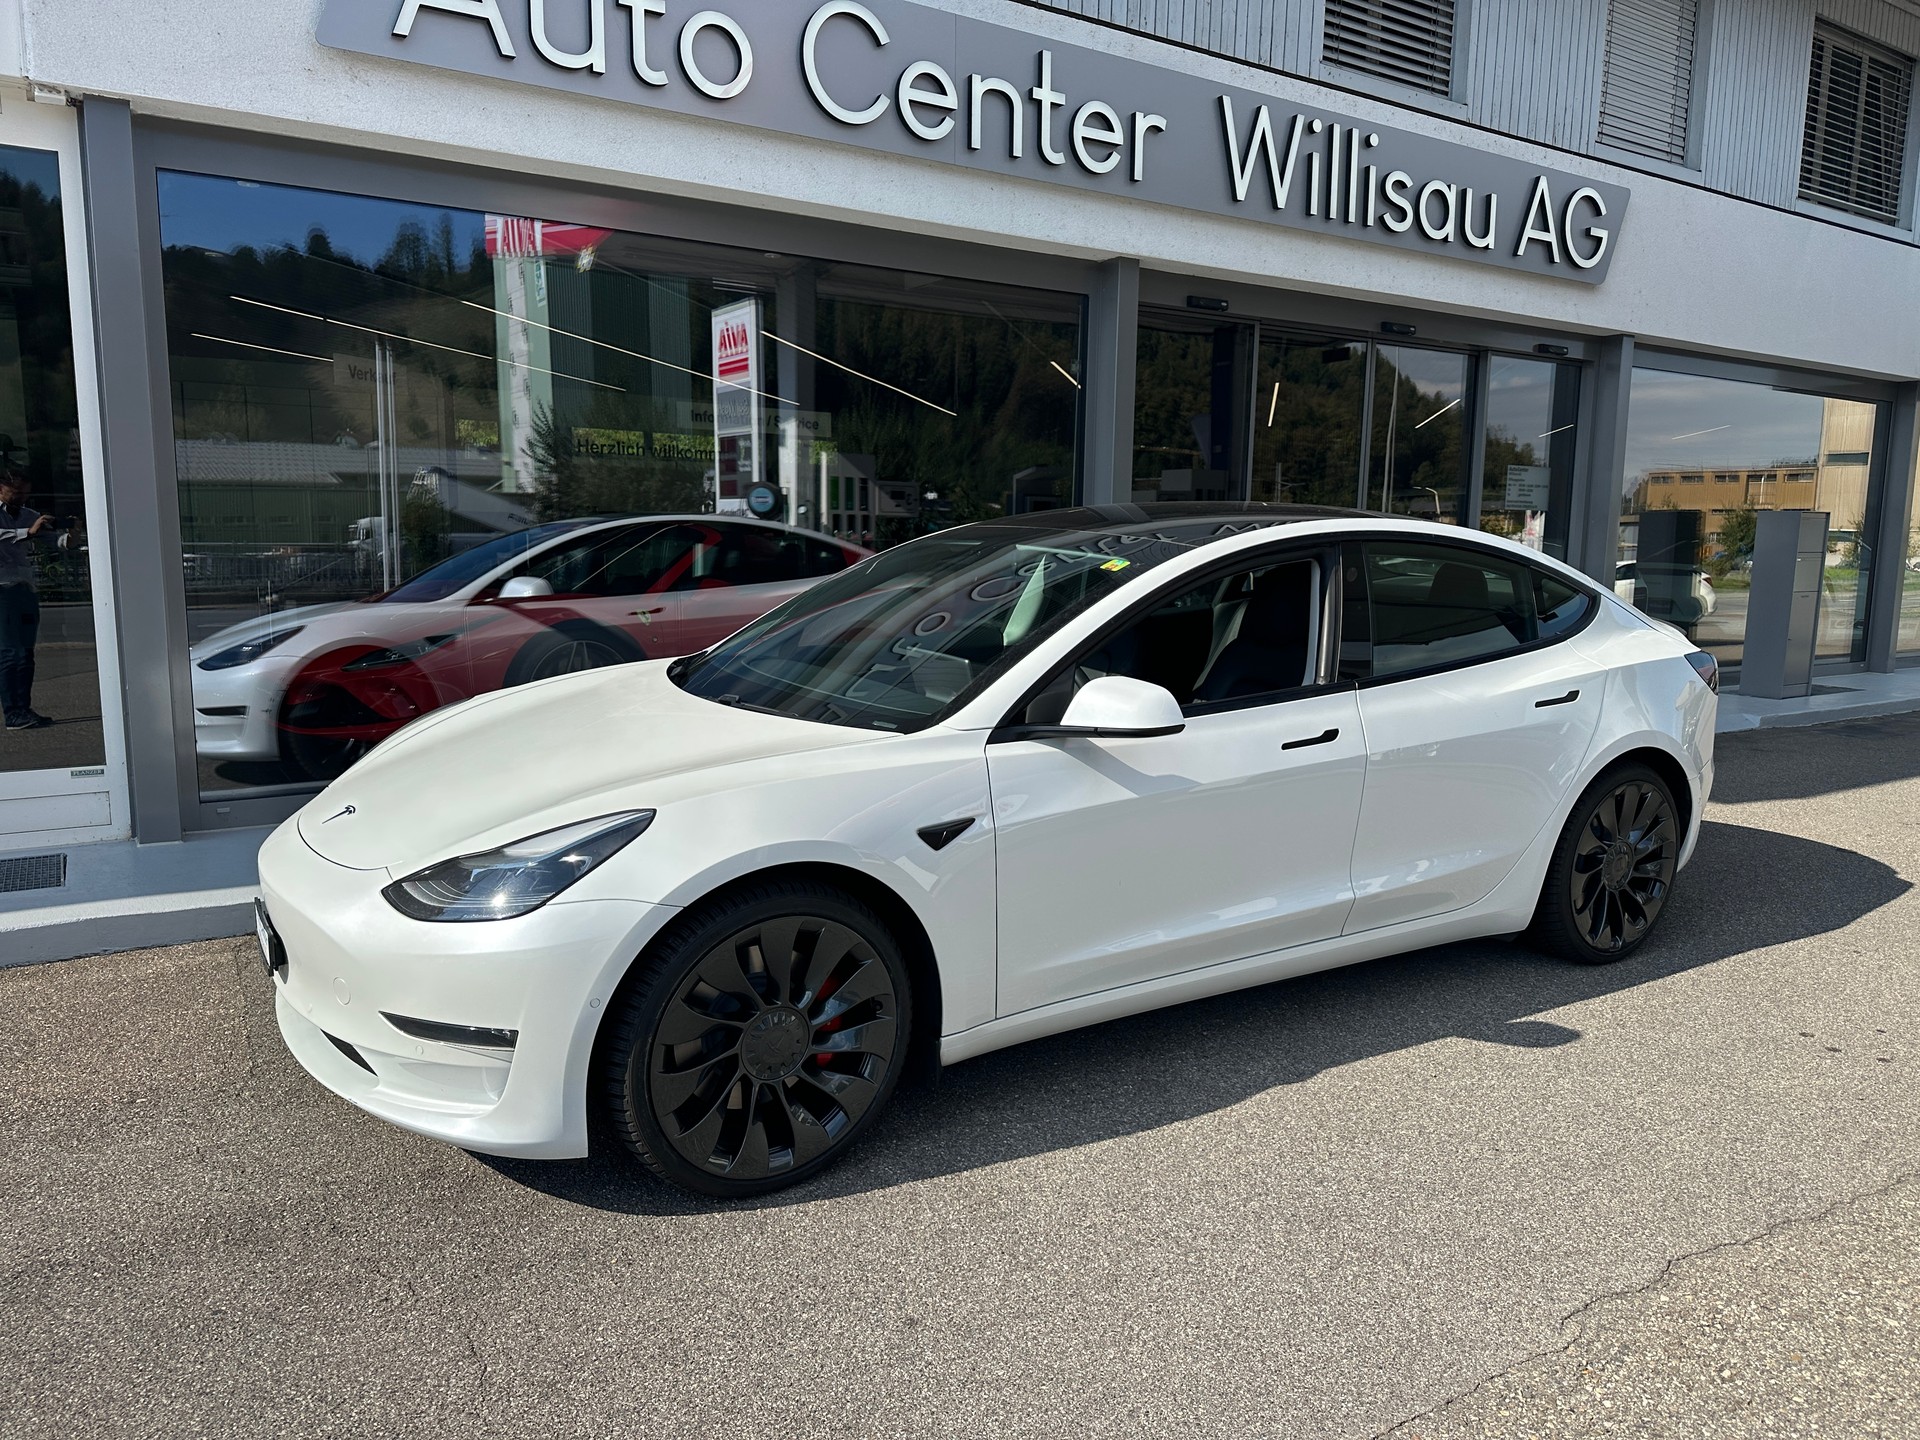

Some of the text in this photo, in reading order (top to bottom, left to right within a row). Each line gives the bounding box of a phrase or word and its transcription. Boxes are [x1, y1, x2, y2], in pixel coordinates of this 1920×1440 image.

[800, 0, 1167, 182] Center
[1217, 95, 1497, 249] Willisau
[1514, 175, 1608, 270] AG
[347, 364, 397, 386] Verkf
[691, 409, 762, 427] Infomati
[577, 438, 645, 457] Herzlich
